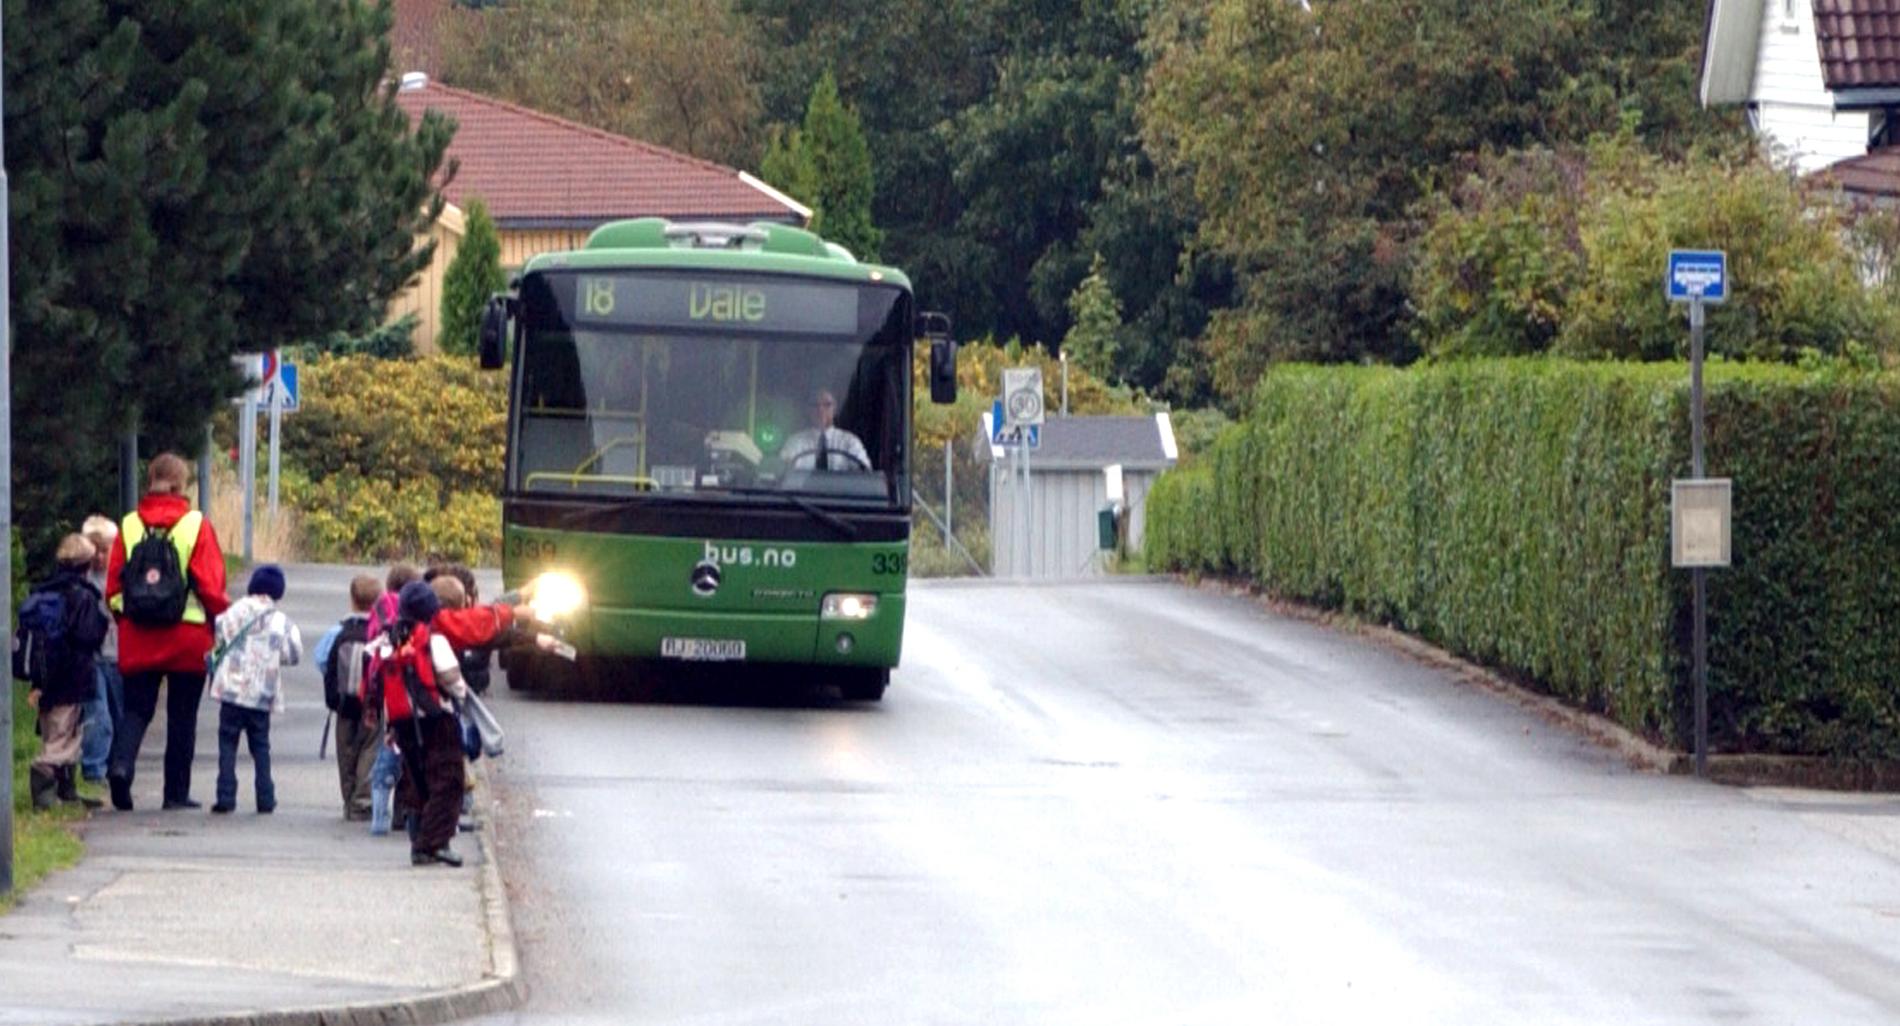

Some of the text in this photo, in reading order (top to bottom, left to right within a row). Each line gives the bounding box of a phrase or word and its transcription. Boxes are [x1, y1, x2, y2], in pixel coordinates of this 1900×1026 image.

[584, 275, 767, 321] 18 Dale
[704, 540, 797, 567] bus.no
